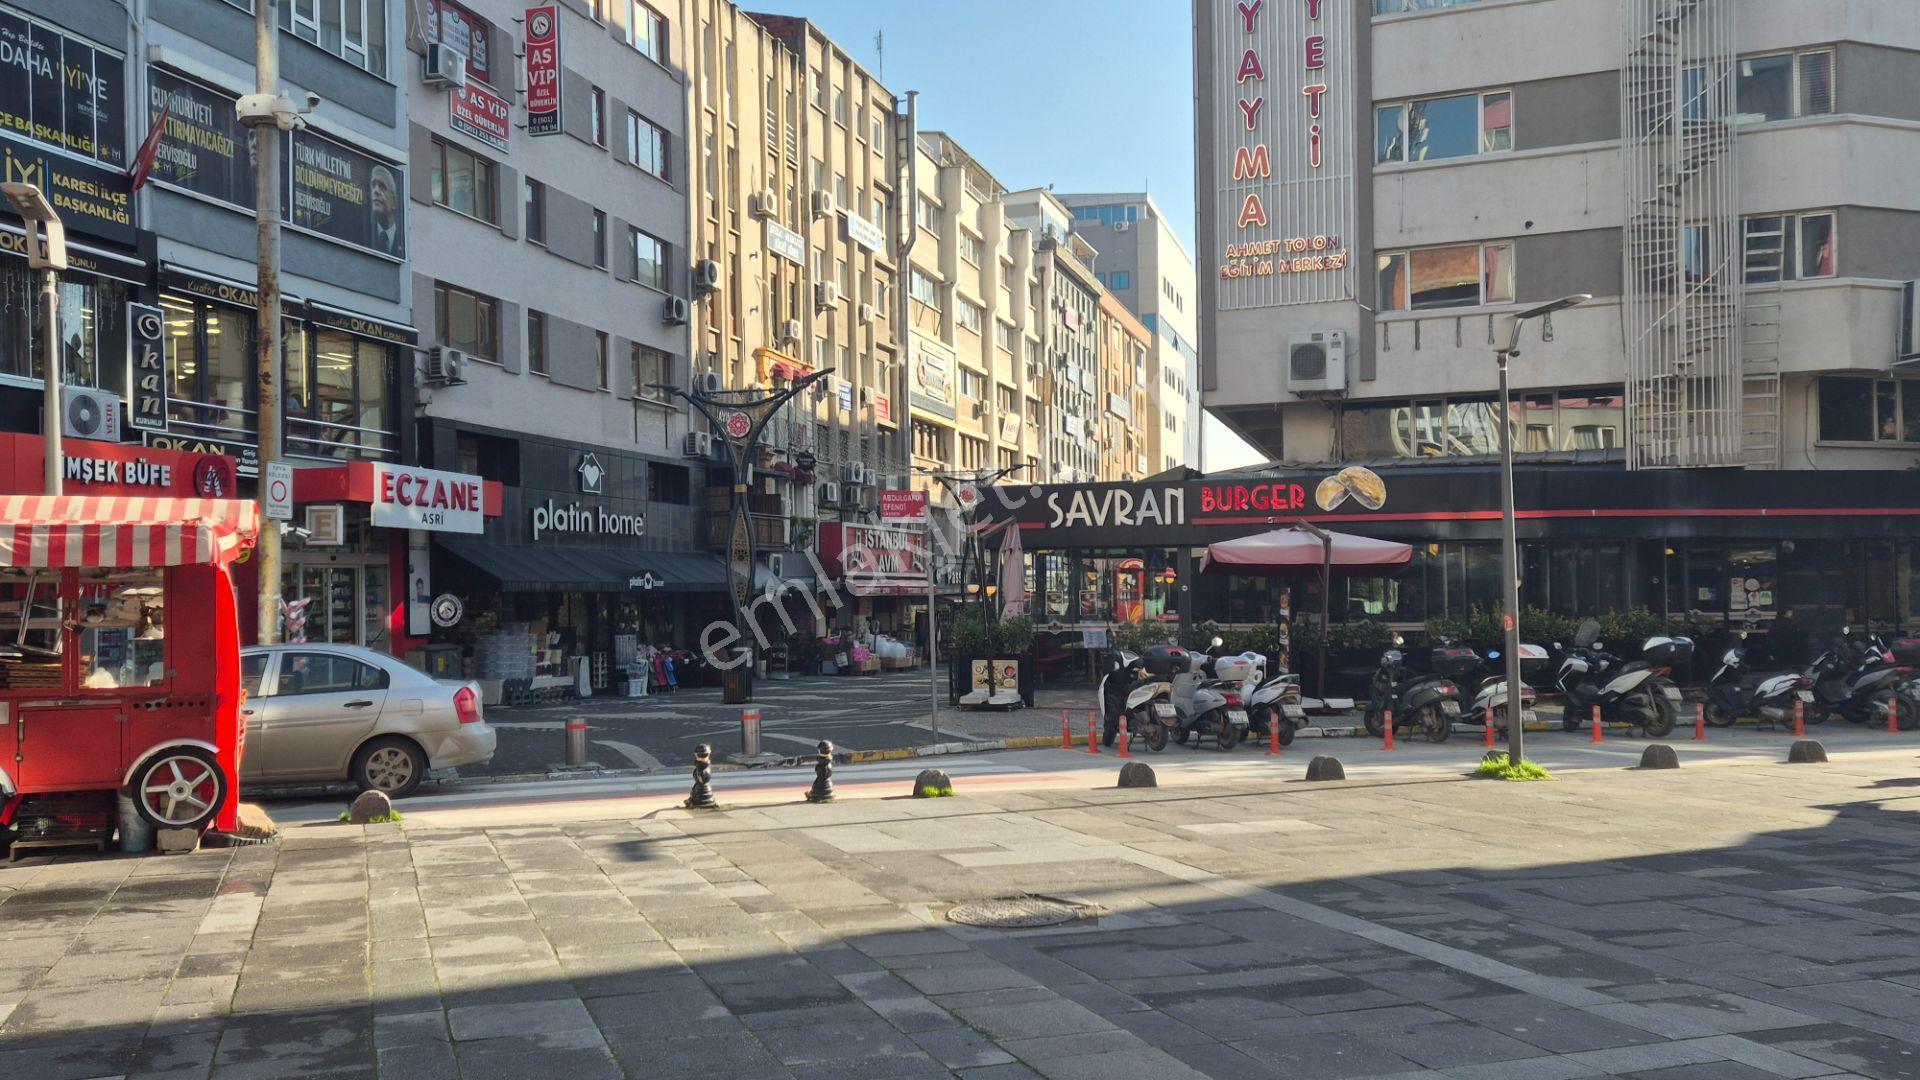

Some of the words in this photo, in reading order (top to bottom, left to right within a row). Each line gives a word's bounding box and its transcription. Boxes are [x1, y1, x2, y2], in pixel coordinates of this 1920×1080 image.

[0, 40, 54, 80] DAHA
[532, 48, 552, 65] AS
[528, 66, 556, 86] VİP
[152, 85, 212, 126] CUMHURİYETİ
[456, 104, 473, 120] ÖZEL
[474, 114, 504, 136] GÜVENLİK
[471, 92, 484, 110] AS
[488, 100, 507, 120] VİP
[14, 118, 95, 154] BAŞKANLIĞI
[295, 141, 314, 166] TÜRK
[52, 172, 98, 199] KARESİ
[100, 182, 128, 206] İLÇE
[54, 194, 130, 225] BAŞKANLIĞI
[1226, 239, 1280, 258] AHMET
[1284, 235, 1338, 252] TOLON
[1220, 258, 1274, 278] EĞİTİM
[1280, 250, 1348, 274] MERKEZİ
[218, 284, 258, 306] OKAN
[351, 318, 383, 337] OKAN
[61, 451, 118, 485] İMŞEK
[126, 458, 171, 487] BÜFE
[380, 471, 480, 512] ECZANE
[1202, 483, 1306, 512] BURGER
[422, 511, 444, 525] ASRİ
[533, 499, 592, 540] platin
[598, 505, 644, 536] home
[1048, 486, 1184, 529] SAVRAN
[880, 554, 898, 573] AVM
